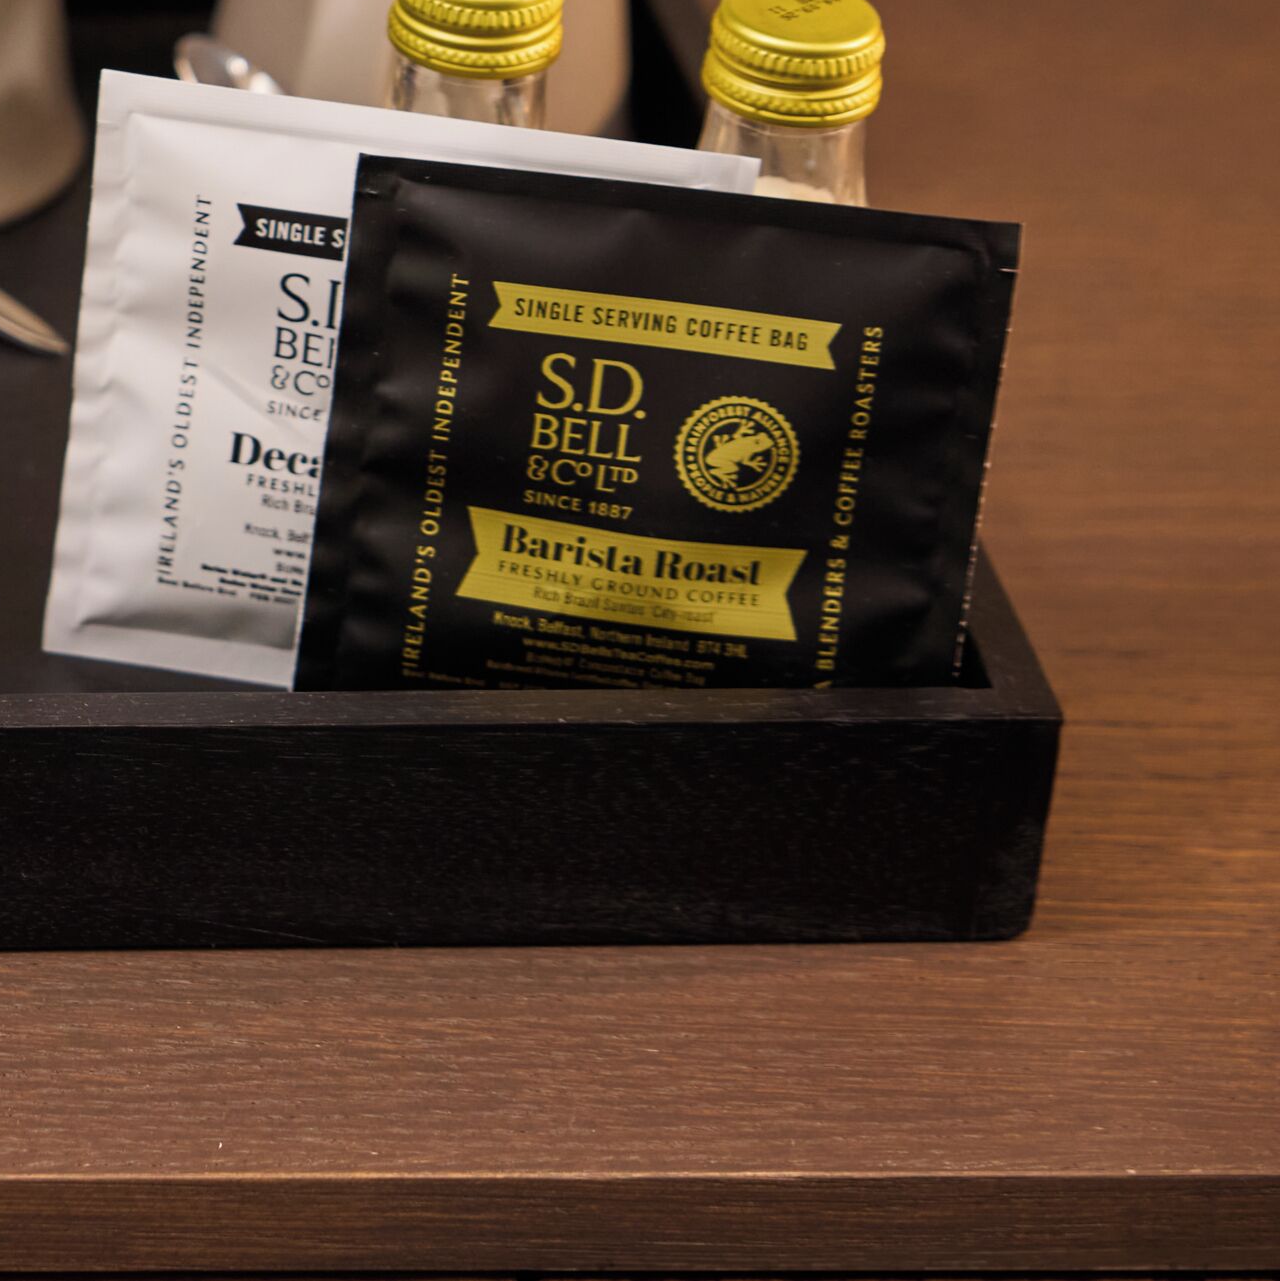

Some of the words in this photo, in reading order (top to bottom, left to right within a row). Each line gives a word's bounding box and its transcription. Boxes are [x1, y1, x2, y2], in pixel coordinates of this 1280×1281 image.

[255, 218, 327, 247] SINGLE
[513, 297, 585, 323] SINGLE
[592, 306, 677, 334] SERVING
[685, 317, 763, 345] COFFEE
[769, 328, 809, 351] BAG
[157, 458, 185, 575] IRELAND'S
[171, 356, 199, 449] OLDEST
[185, 194, 212, 349] INDEPENDENT
[431, 273, 470, 442] INDEPENDENT
[536, 352, 646, 420] S.D.
[266, 400, 325, 422] SINCE
[530, 412, 642, 463] BELL
[420, 449, 448, 536] OLDEST
[523, 489, 582, 513] SINCE
[588, 500, 634, 520] 1887
[814, 556, 847, 671] BLENDERS
[833, 447, 864, 526] COFFEE
[849, 326, 885, 440] ROASTERS
[497, 560, 584, 587] FRESHLY
[590, 577, 679, 602] GROUND
[685, 588, 761, 607] COFFEE
[501, 523, 643, 577] Barista
[654, 549, 762, 586] Roast
[401, 545, 436, 668] IRELAND'S
